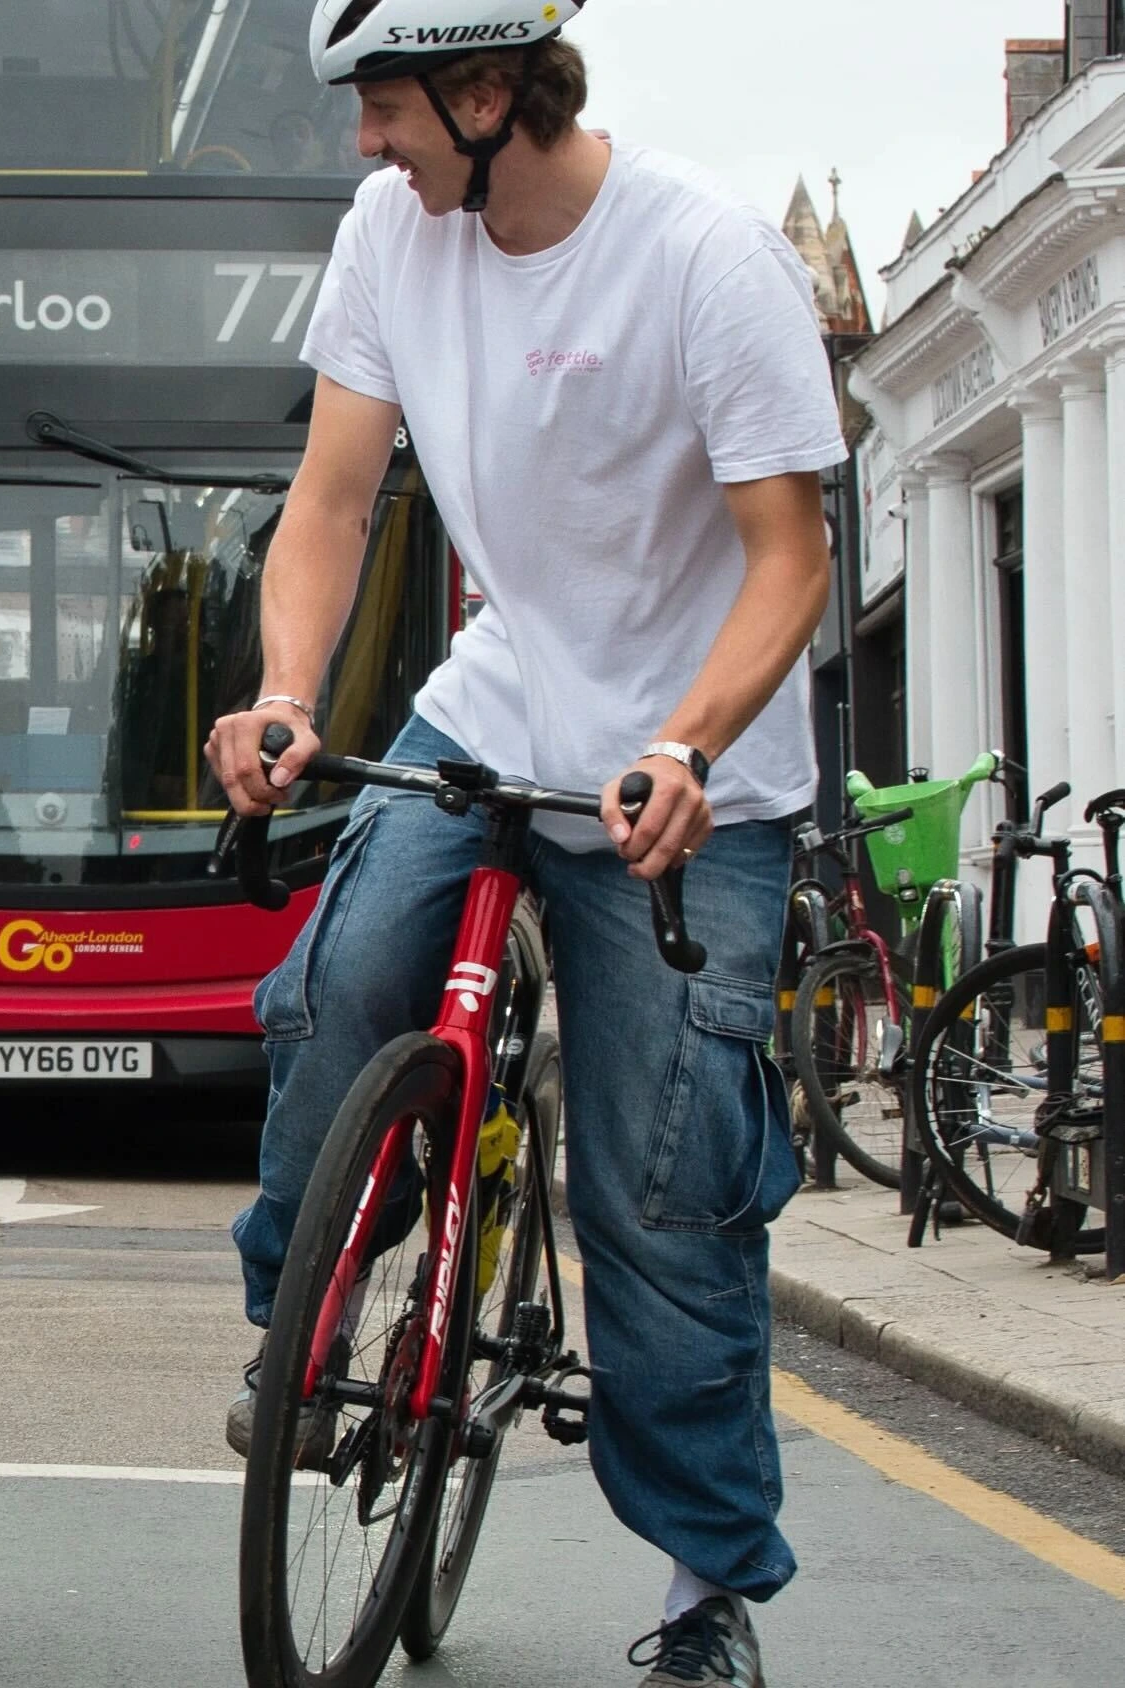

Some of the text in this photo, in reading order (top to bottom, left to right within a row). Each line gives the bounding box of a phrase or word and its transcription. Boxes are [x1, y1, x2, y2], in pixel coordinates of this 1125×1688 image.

[382, 20, 535, 44] S-WORKS
[215, 263, 322, 342] 77
[547, 349, 603, 367] fettle.
[38, 930, 144, 943] Ahead-London
[75, 944, 144, 953] LONDON GENERAL
[0, 1046, 139, 1073] YY66 OYG
[430, 1182, 461, 1345] RIDLEY
